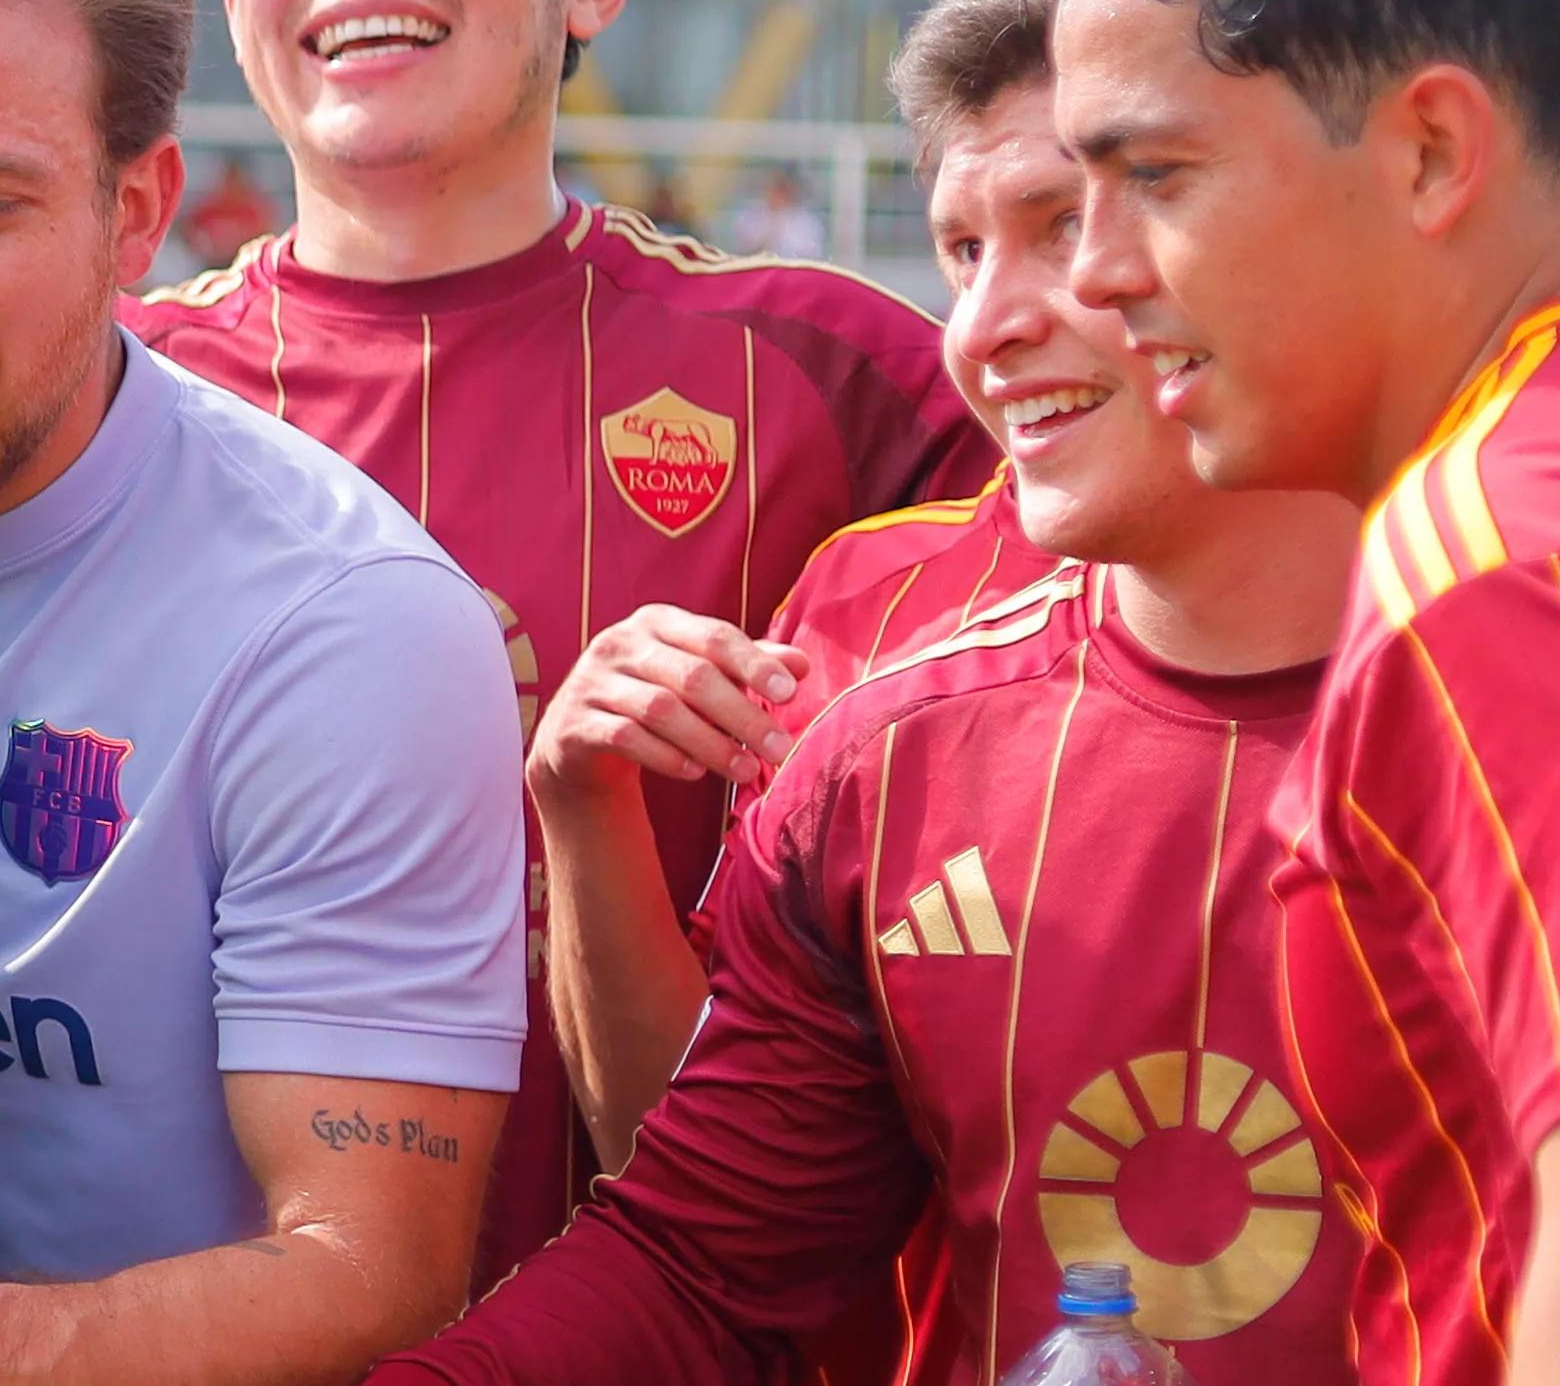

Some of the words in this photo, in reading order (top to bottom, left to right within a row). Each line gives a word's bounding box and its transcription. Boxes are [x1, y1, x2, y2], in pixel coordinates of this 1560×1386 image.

[628, 467, 715, 494] ROMA
[656, 498, 689, 514] 1927
[400, 1117, 459, 1163] Plan
